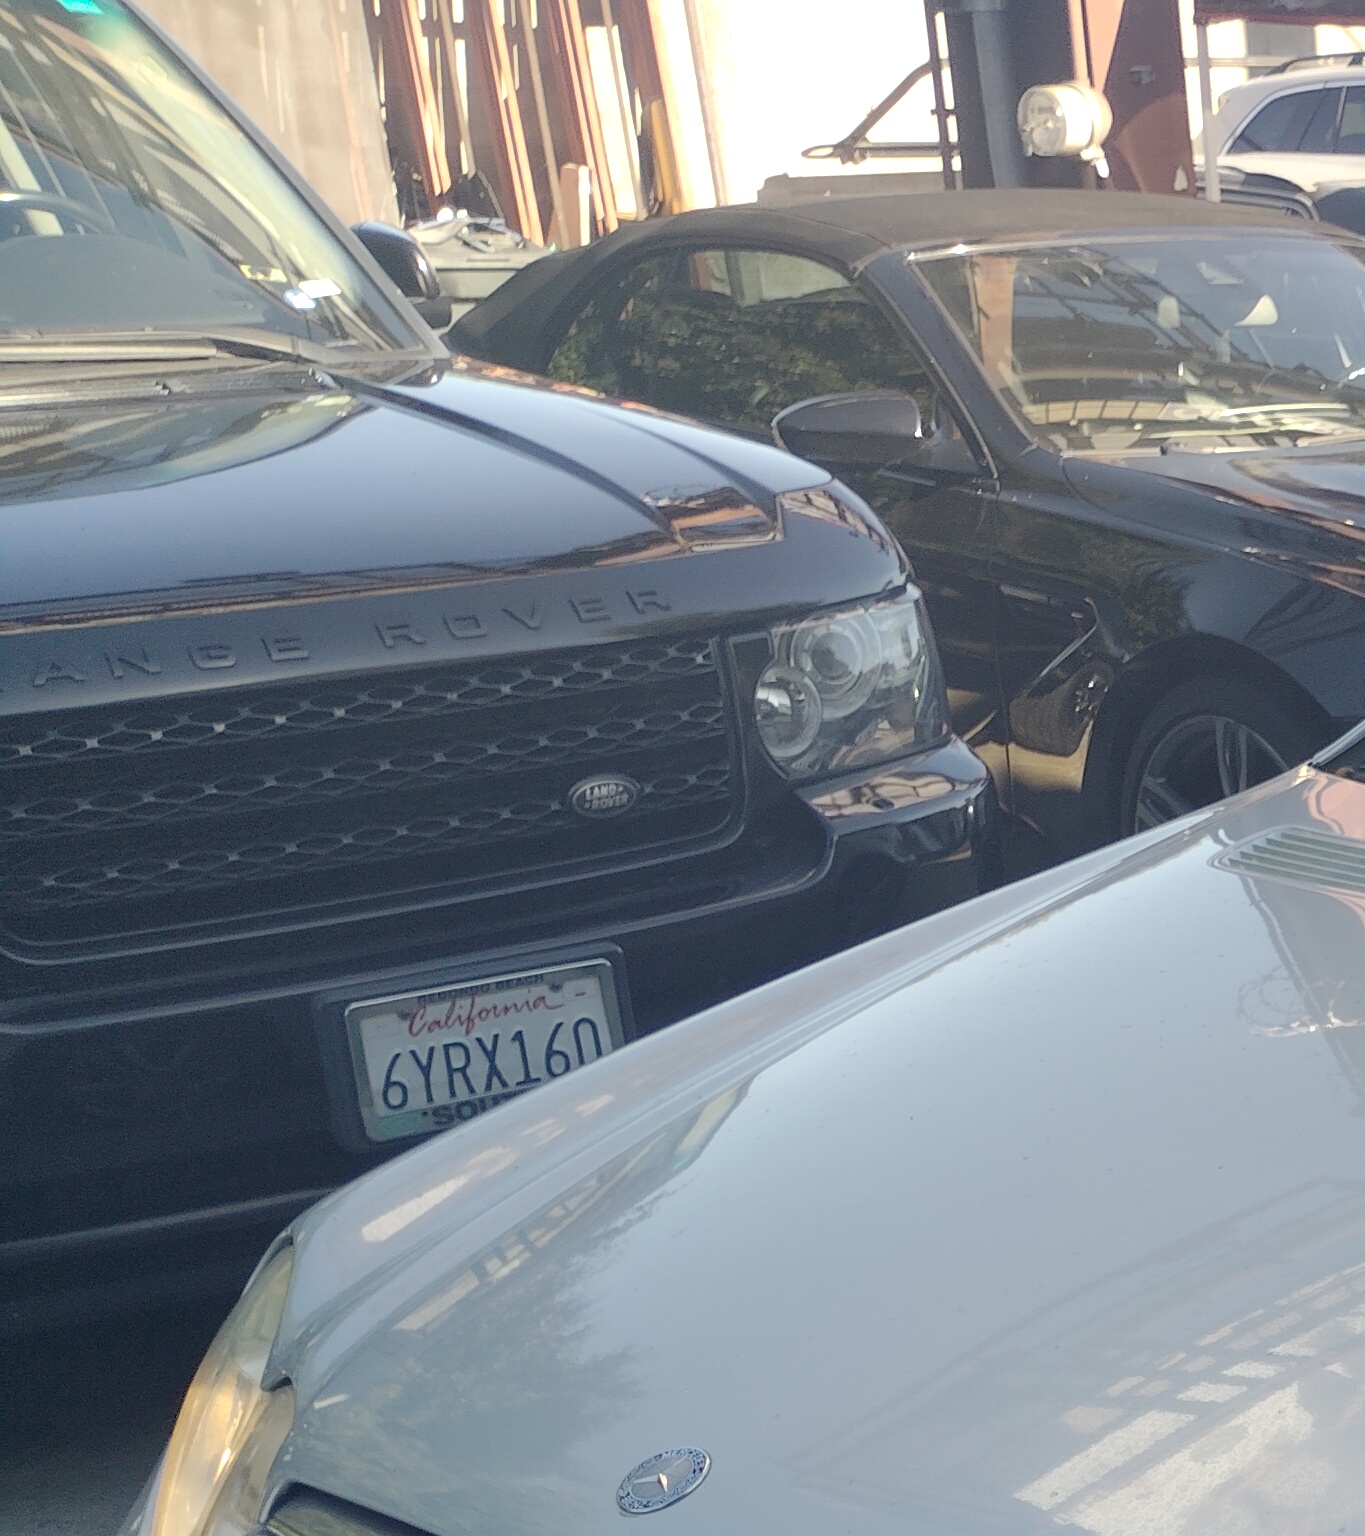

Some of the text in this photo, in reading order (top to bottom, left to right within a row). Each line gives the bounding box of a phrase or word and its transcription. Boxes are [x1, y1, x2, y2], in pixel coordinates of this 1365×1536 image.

[0, 588, 672, 692] ANGE ROVER
[408, 991, 566, 1038] California
[381, 1016, 602, 1110] 6YRX160
